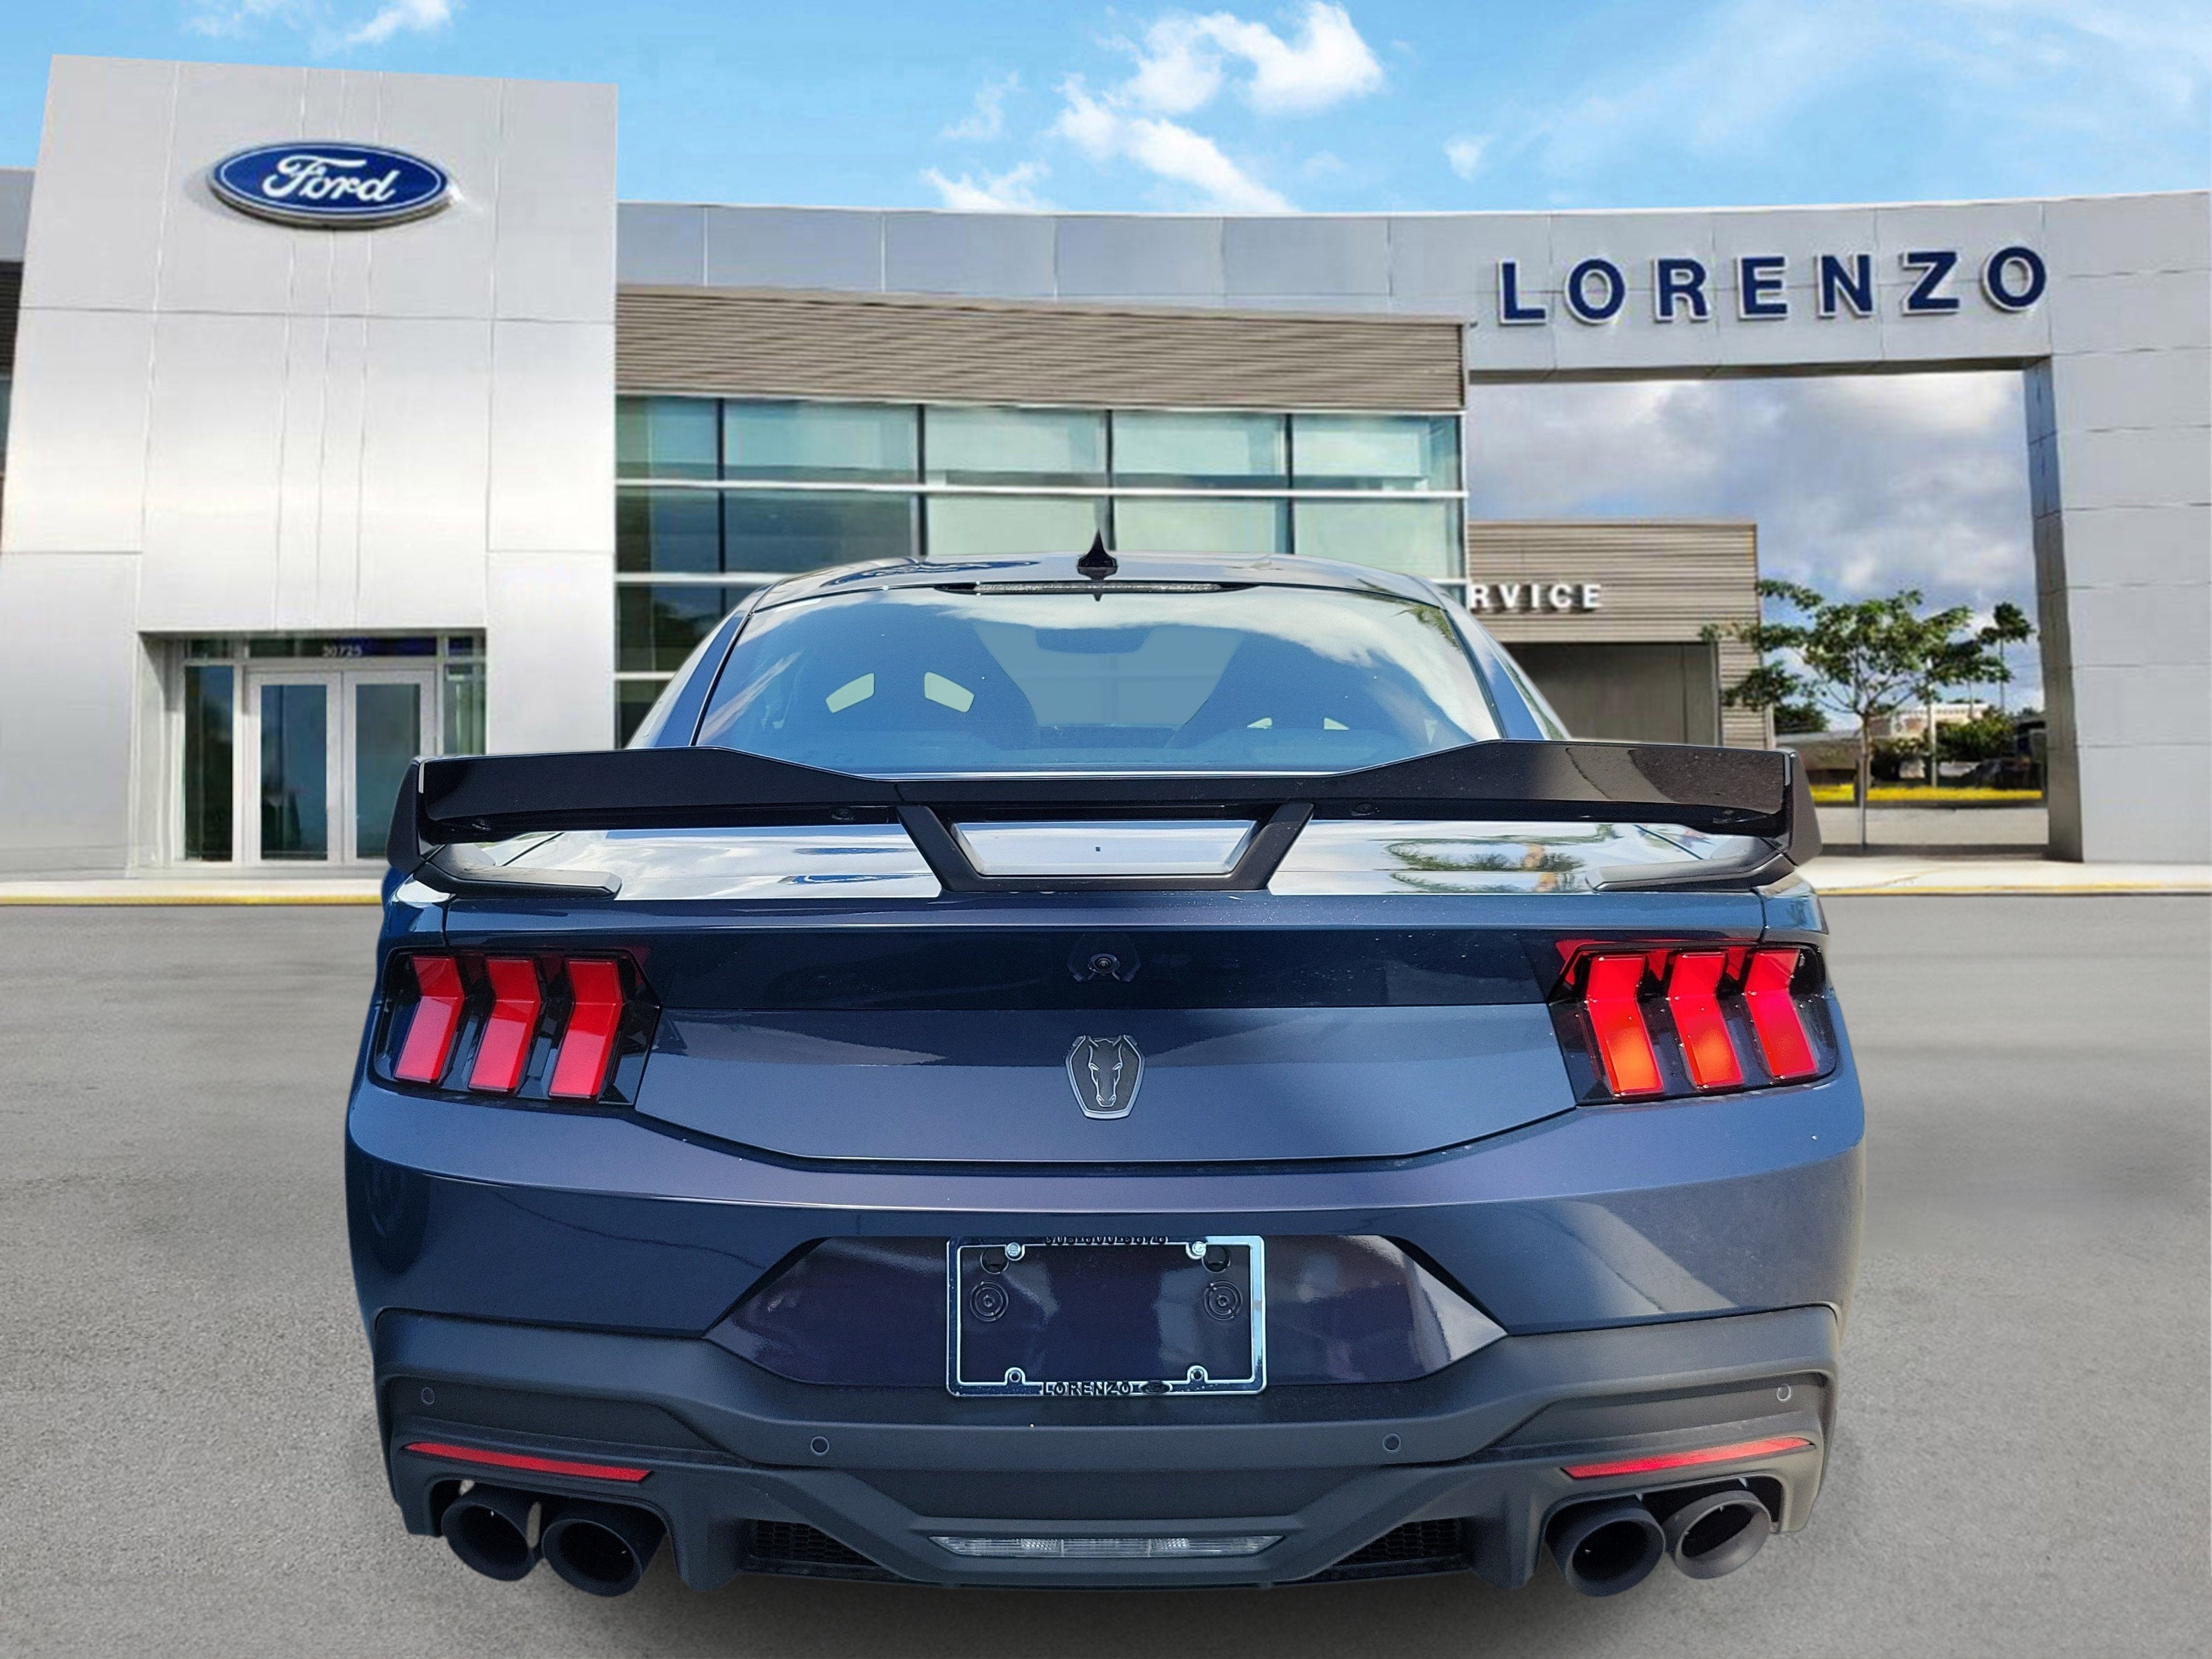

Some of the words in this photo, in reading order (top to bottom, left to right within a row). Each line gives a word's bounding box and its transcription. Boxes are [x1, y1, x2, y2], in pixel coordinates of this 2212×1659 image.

[262, 154, 400, 202] Ford
[1498, 246, 2046, 324] LORENZO
[1469, 584, 1602, 608] RVICE
[1043, 1381, 1132, 1396] LORENZO
